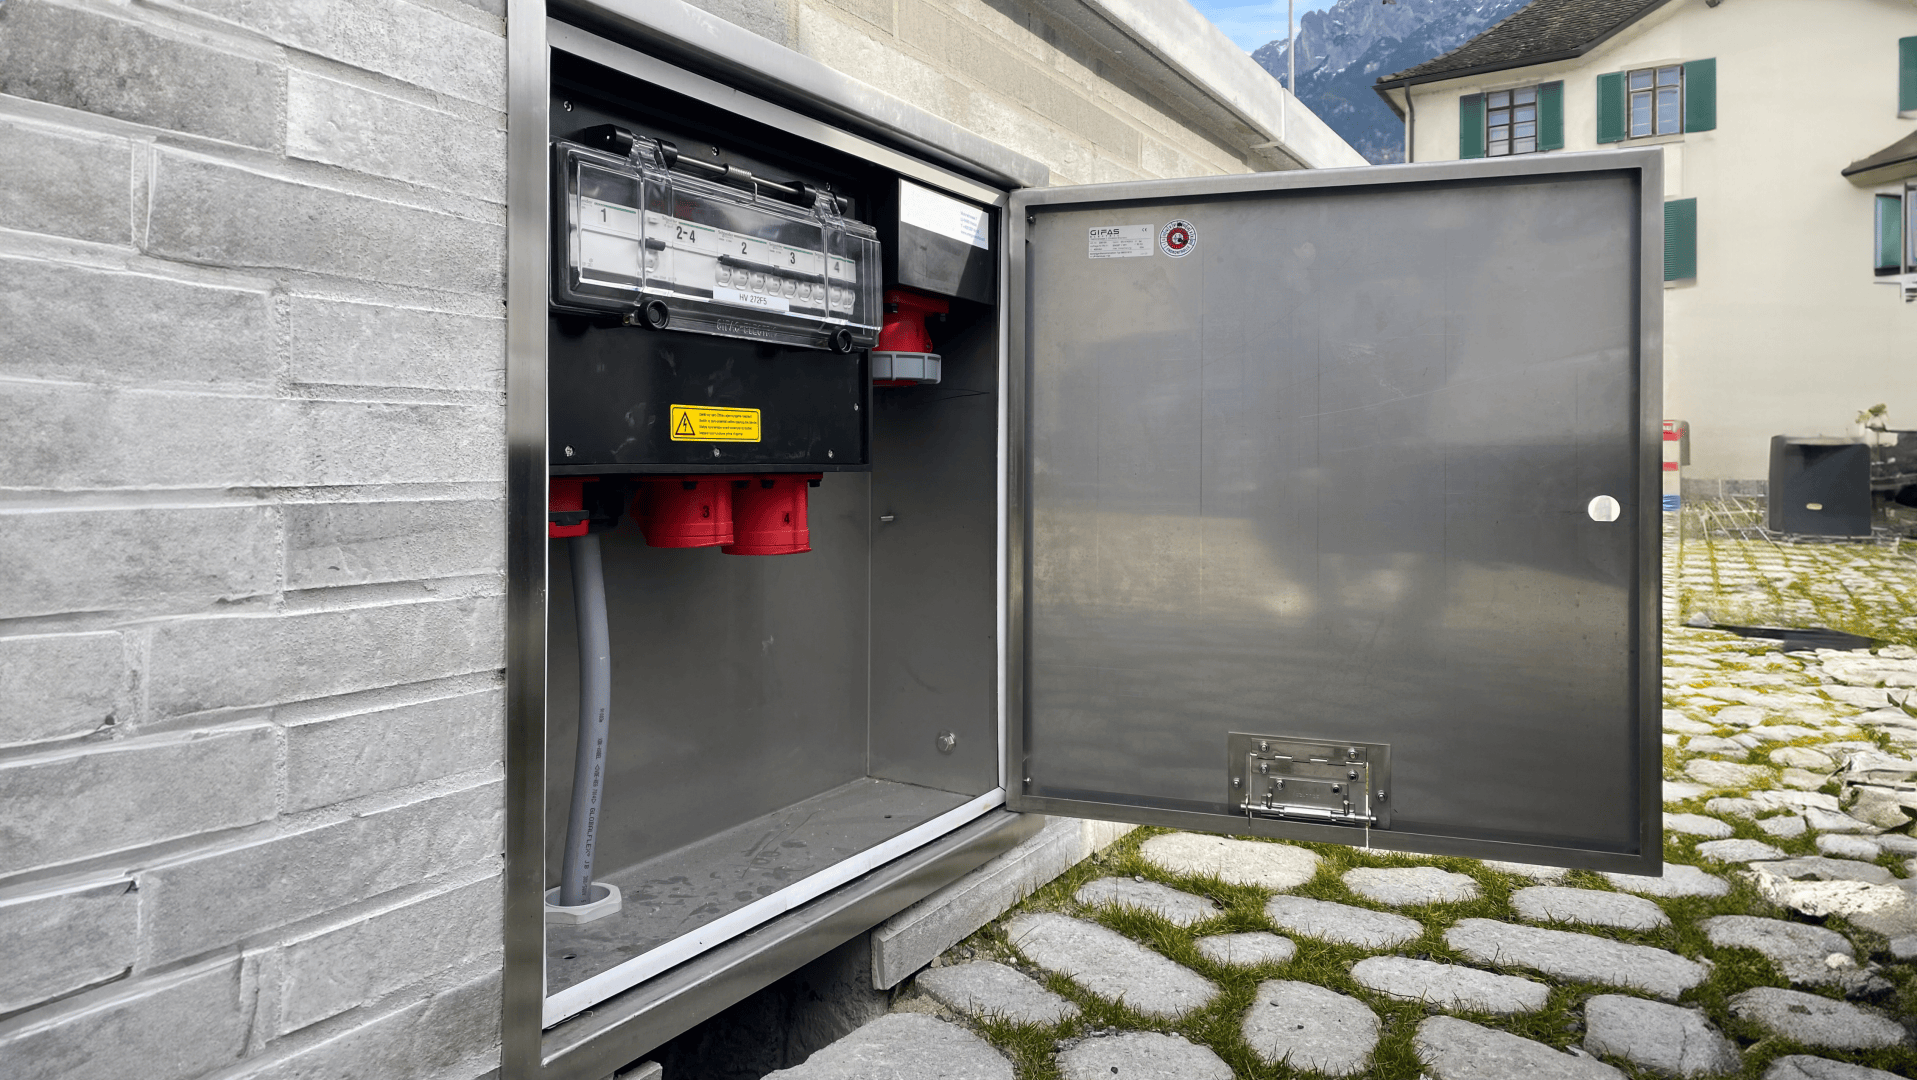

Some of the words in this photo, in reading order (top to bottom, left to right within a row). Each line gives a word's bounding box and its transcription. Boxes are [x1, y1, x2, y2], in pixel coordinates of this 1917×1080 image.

[600, 207, 607, 223] 1
[676, 226, 695, 243] 2-4
[1090, 228, 1120, 236] GIFAS
[741, 241, 747, 255] 2
[790, 251, 796, 264] 3
[834, 261, 840, 273] 4
[740, 293, 748, 302] HV
[702, 505, 710, 518] 3
[784, 512, 790, 524] 4
